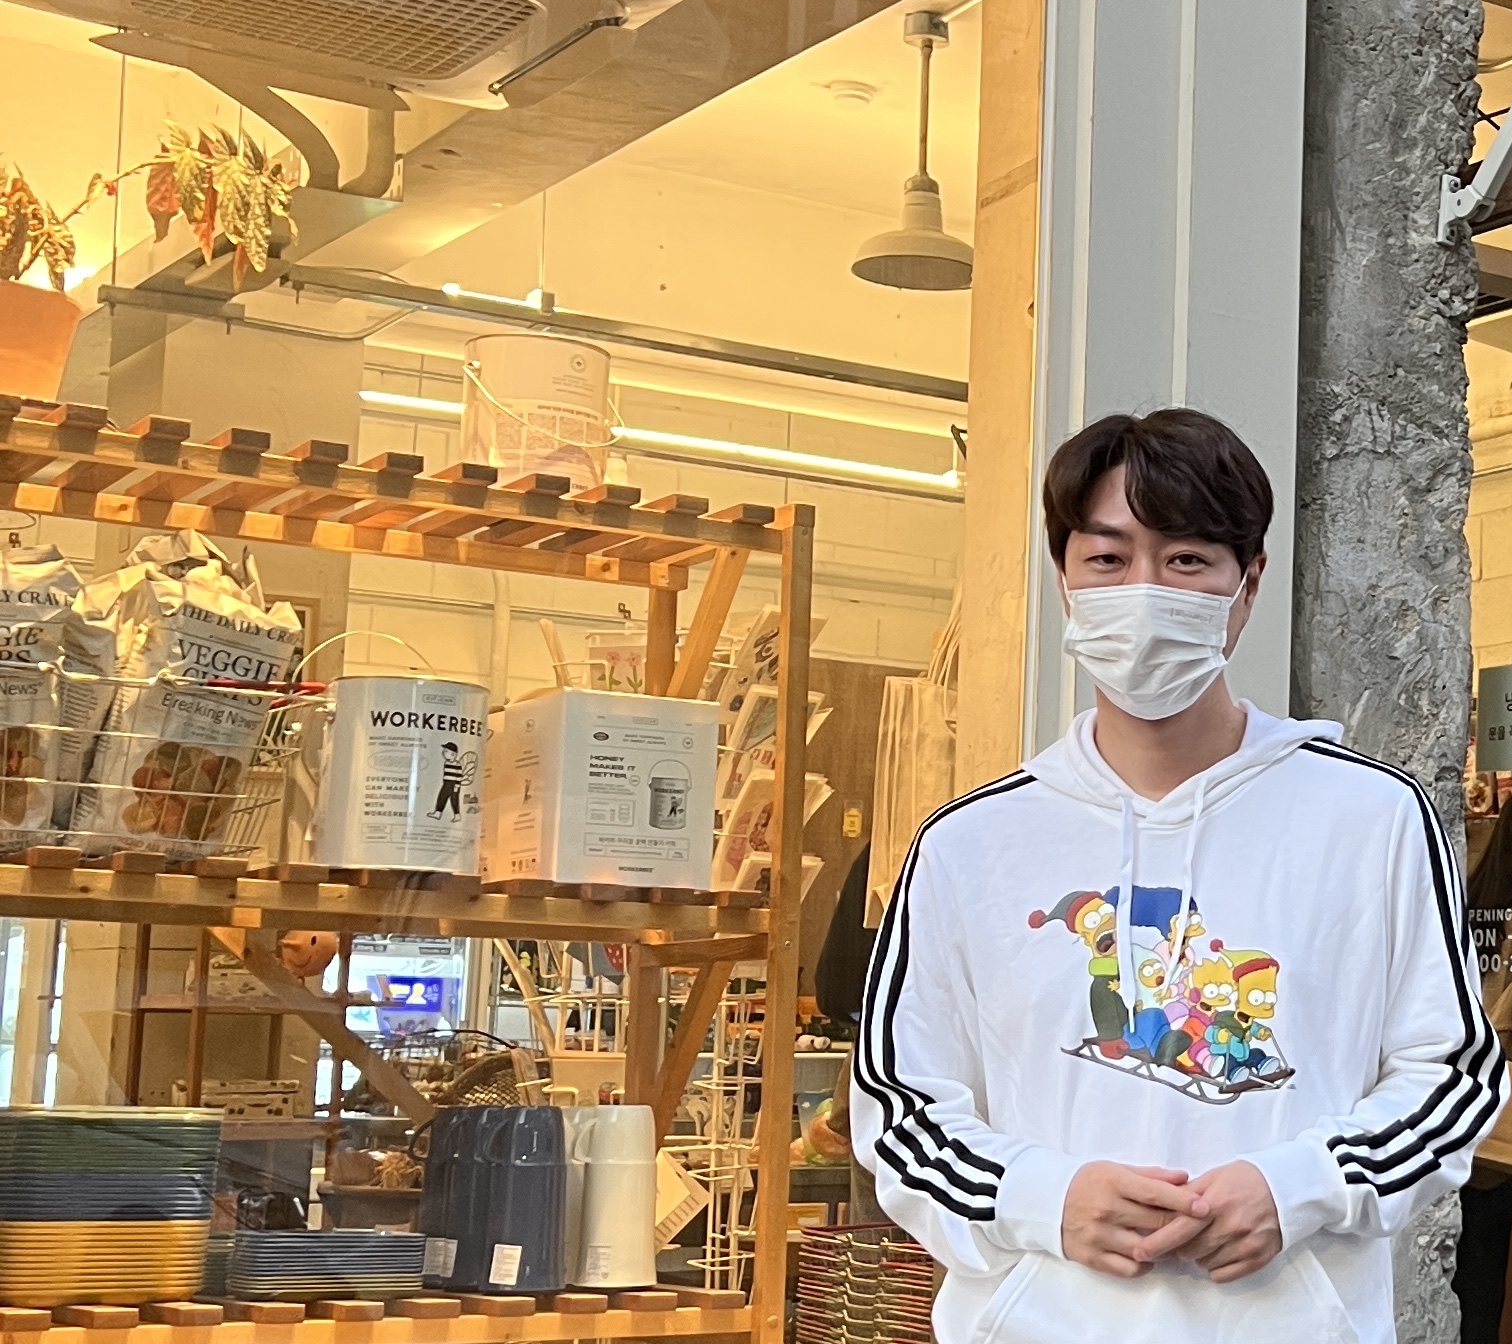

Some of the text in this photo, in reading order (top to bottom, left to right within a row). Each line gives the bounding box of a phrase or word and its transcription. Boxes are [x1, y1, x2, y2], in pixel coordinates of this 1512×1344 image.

[177, 638, 281, 683] VEGGIE
[370, 710, 483, 737] WORKERBEE
[589, 754, 625, 762] HONEY
[589, 762, 624, 771] MAKES
[1468, 908, 1512, 922] PENING
[1473, 927, 1497, 948] ON
